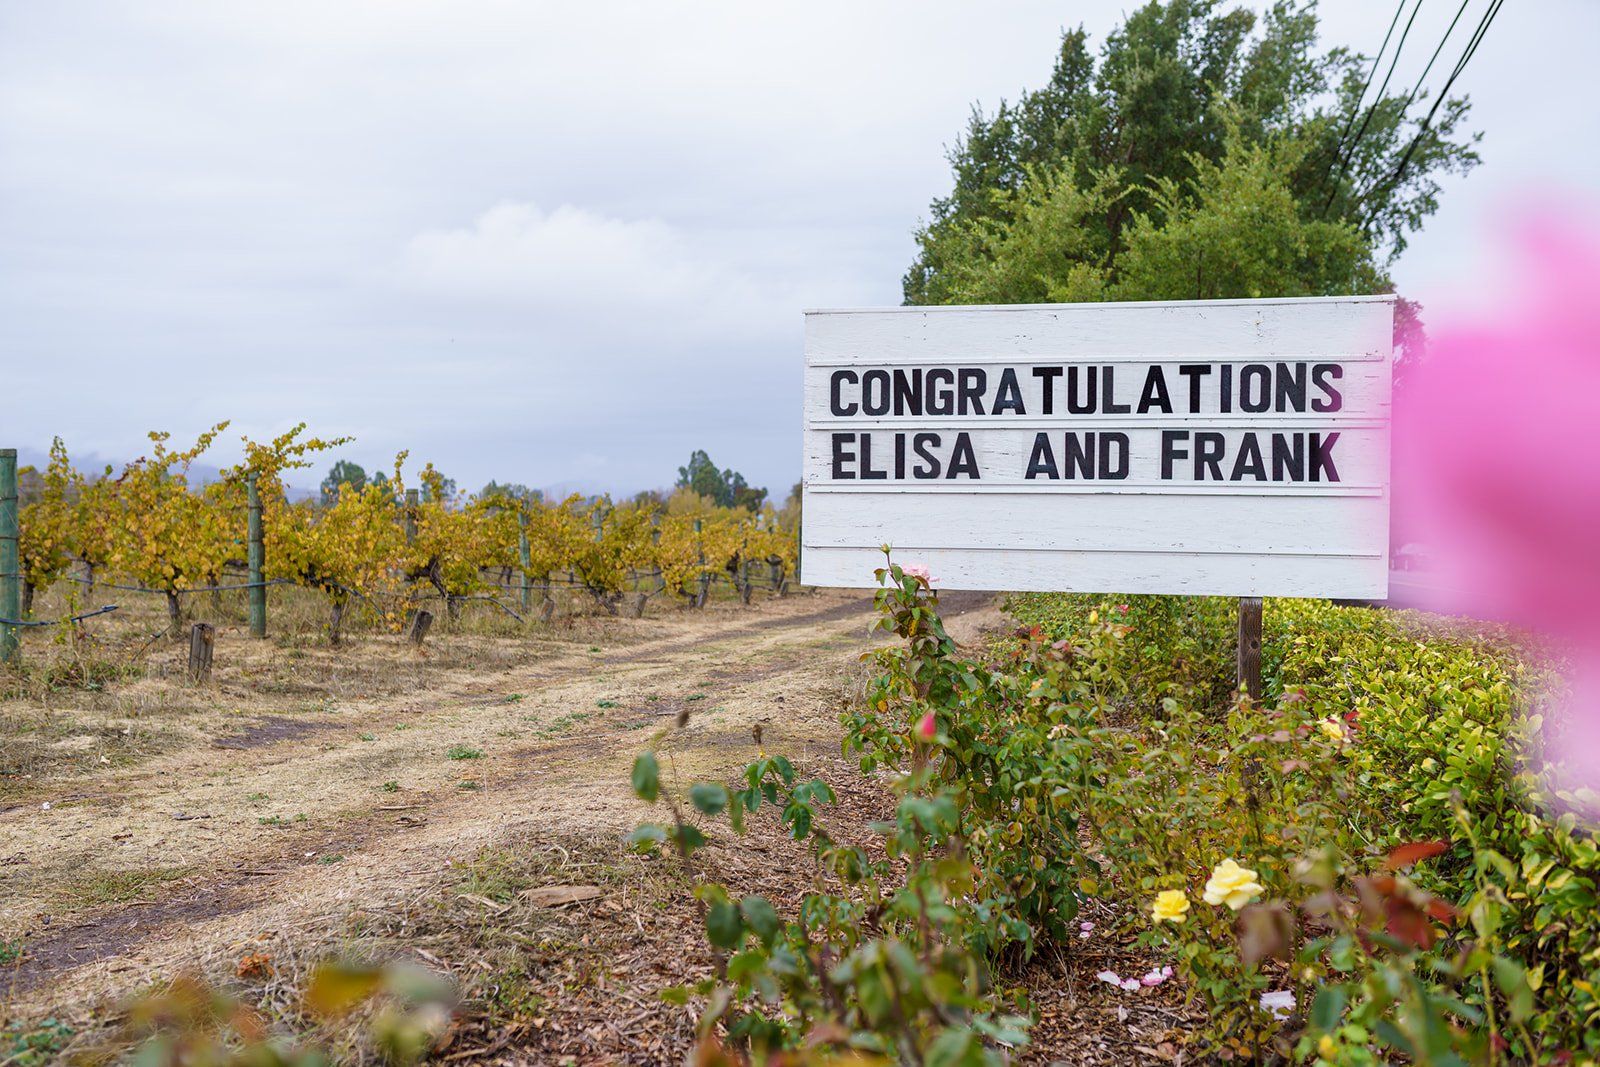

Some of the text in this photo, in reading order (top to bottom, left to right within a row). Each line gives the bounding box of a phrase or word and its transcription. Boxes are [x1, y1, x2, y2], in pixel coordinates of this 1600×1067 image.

[830, 362, 1343, 417] CONGRATULATIONS
[831, 430, 1341, 483] ELISA AND FRANK
